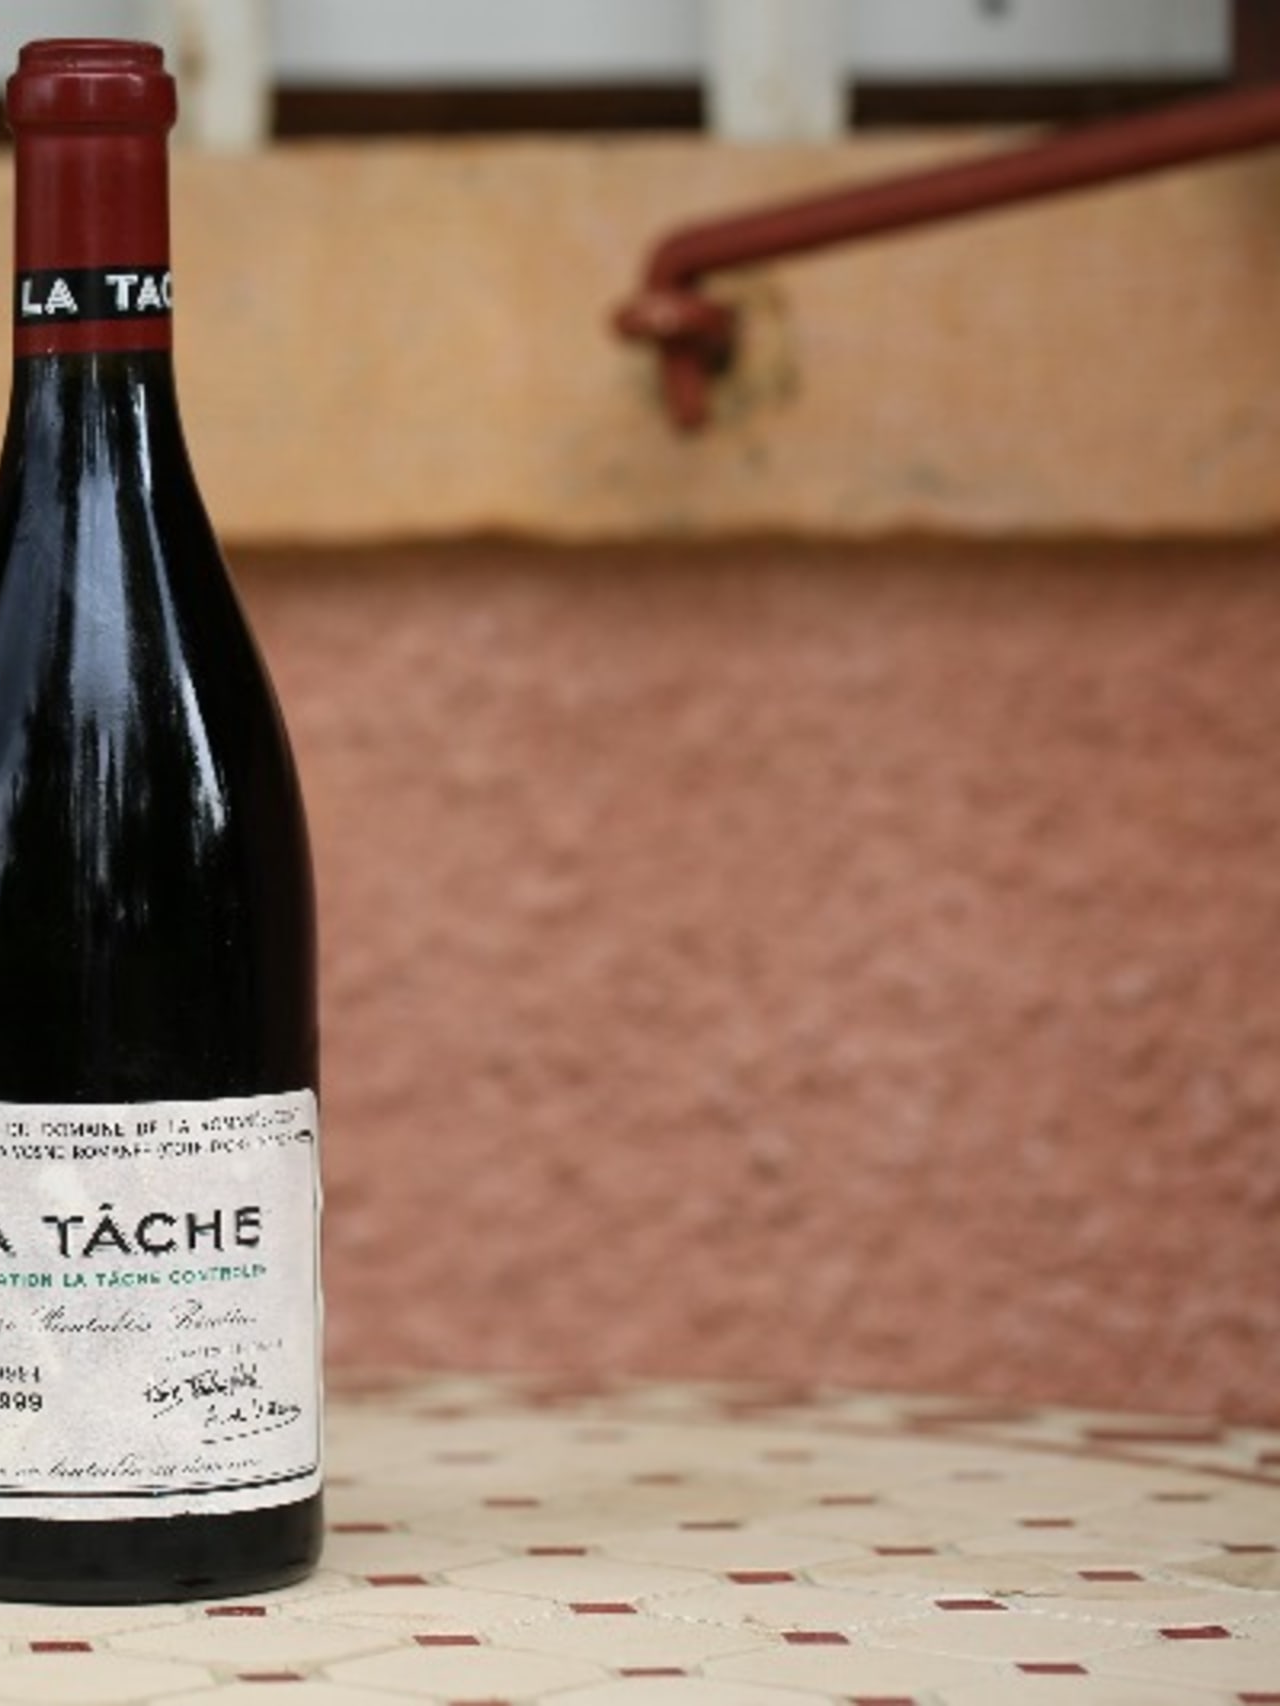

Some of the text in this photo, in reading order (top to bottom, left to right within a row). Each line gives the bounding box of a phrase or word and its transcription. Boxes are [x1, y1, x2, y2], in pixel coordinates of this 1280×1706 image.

[21, 277, 78, 317] LA
[41, 1203, 264, 1259] TÂCHE
[62, 1272, 88, 1289] LA
